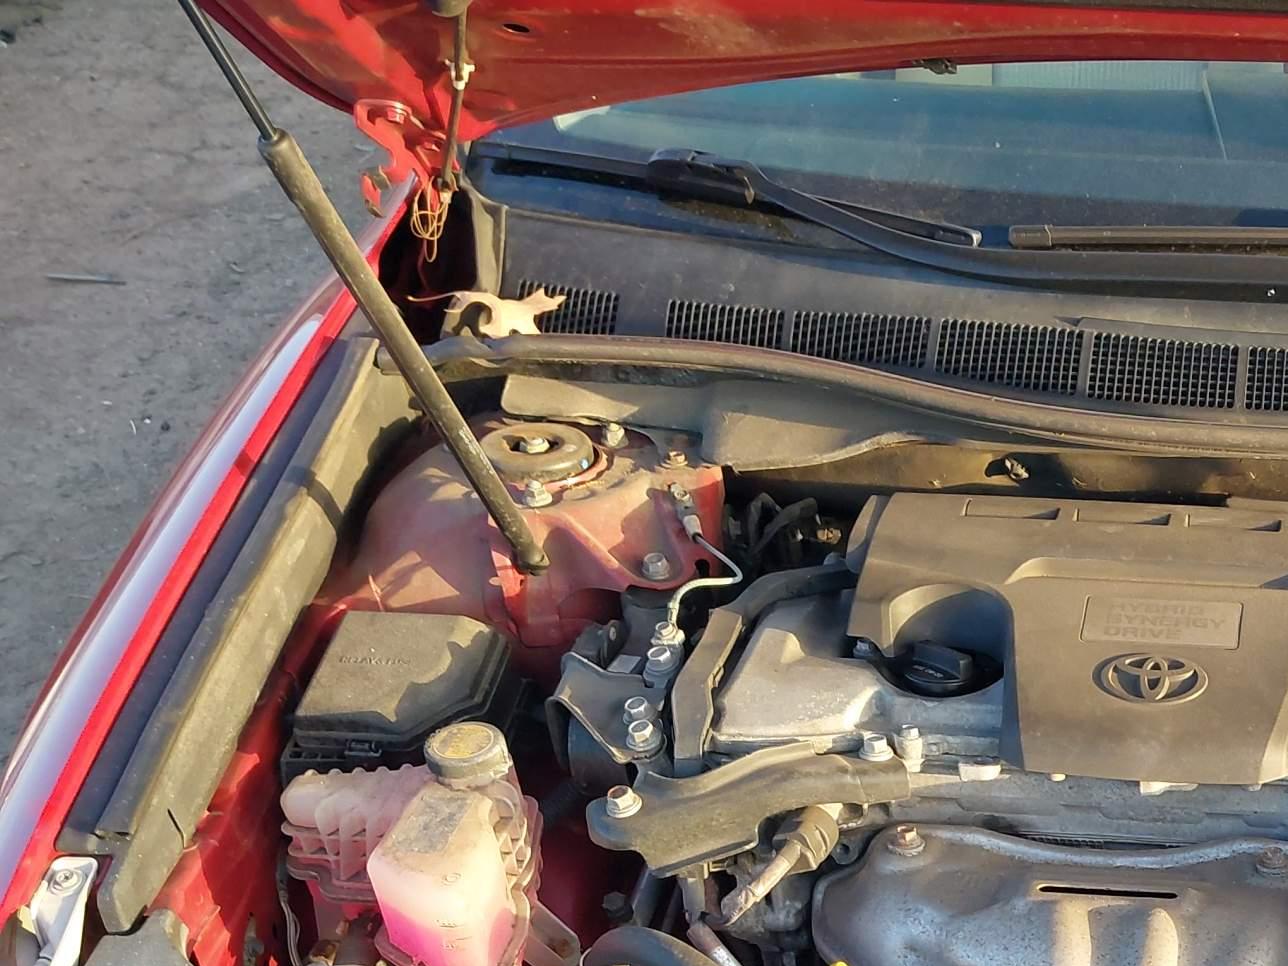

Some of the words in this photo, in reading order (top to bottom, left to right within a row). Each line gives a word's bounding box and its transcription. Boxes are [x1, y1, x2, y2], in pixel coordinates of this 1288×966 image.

[1110, 602, 1204, 616] HYBRID
[1106, 613, 1226, 630] SYNERGY
[1103, 626, 1183, 640] DRIVE
